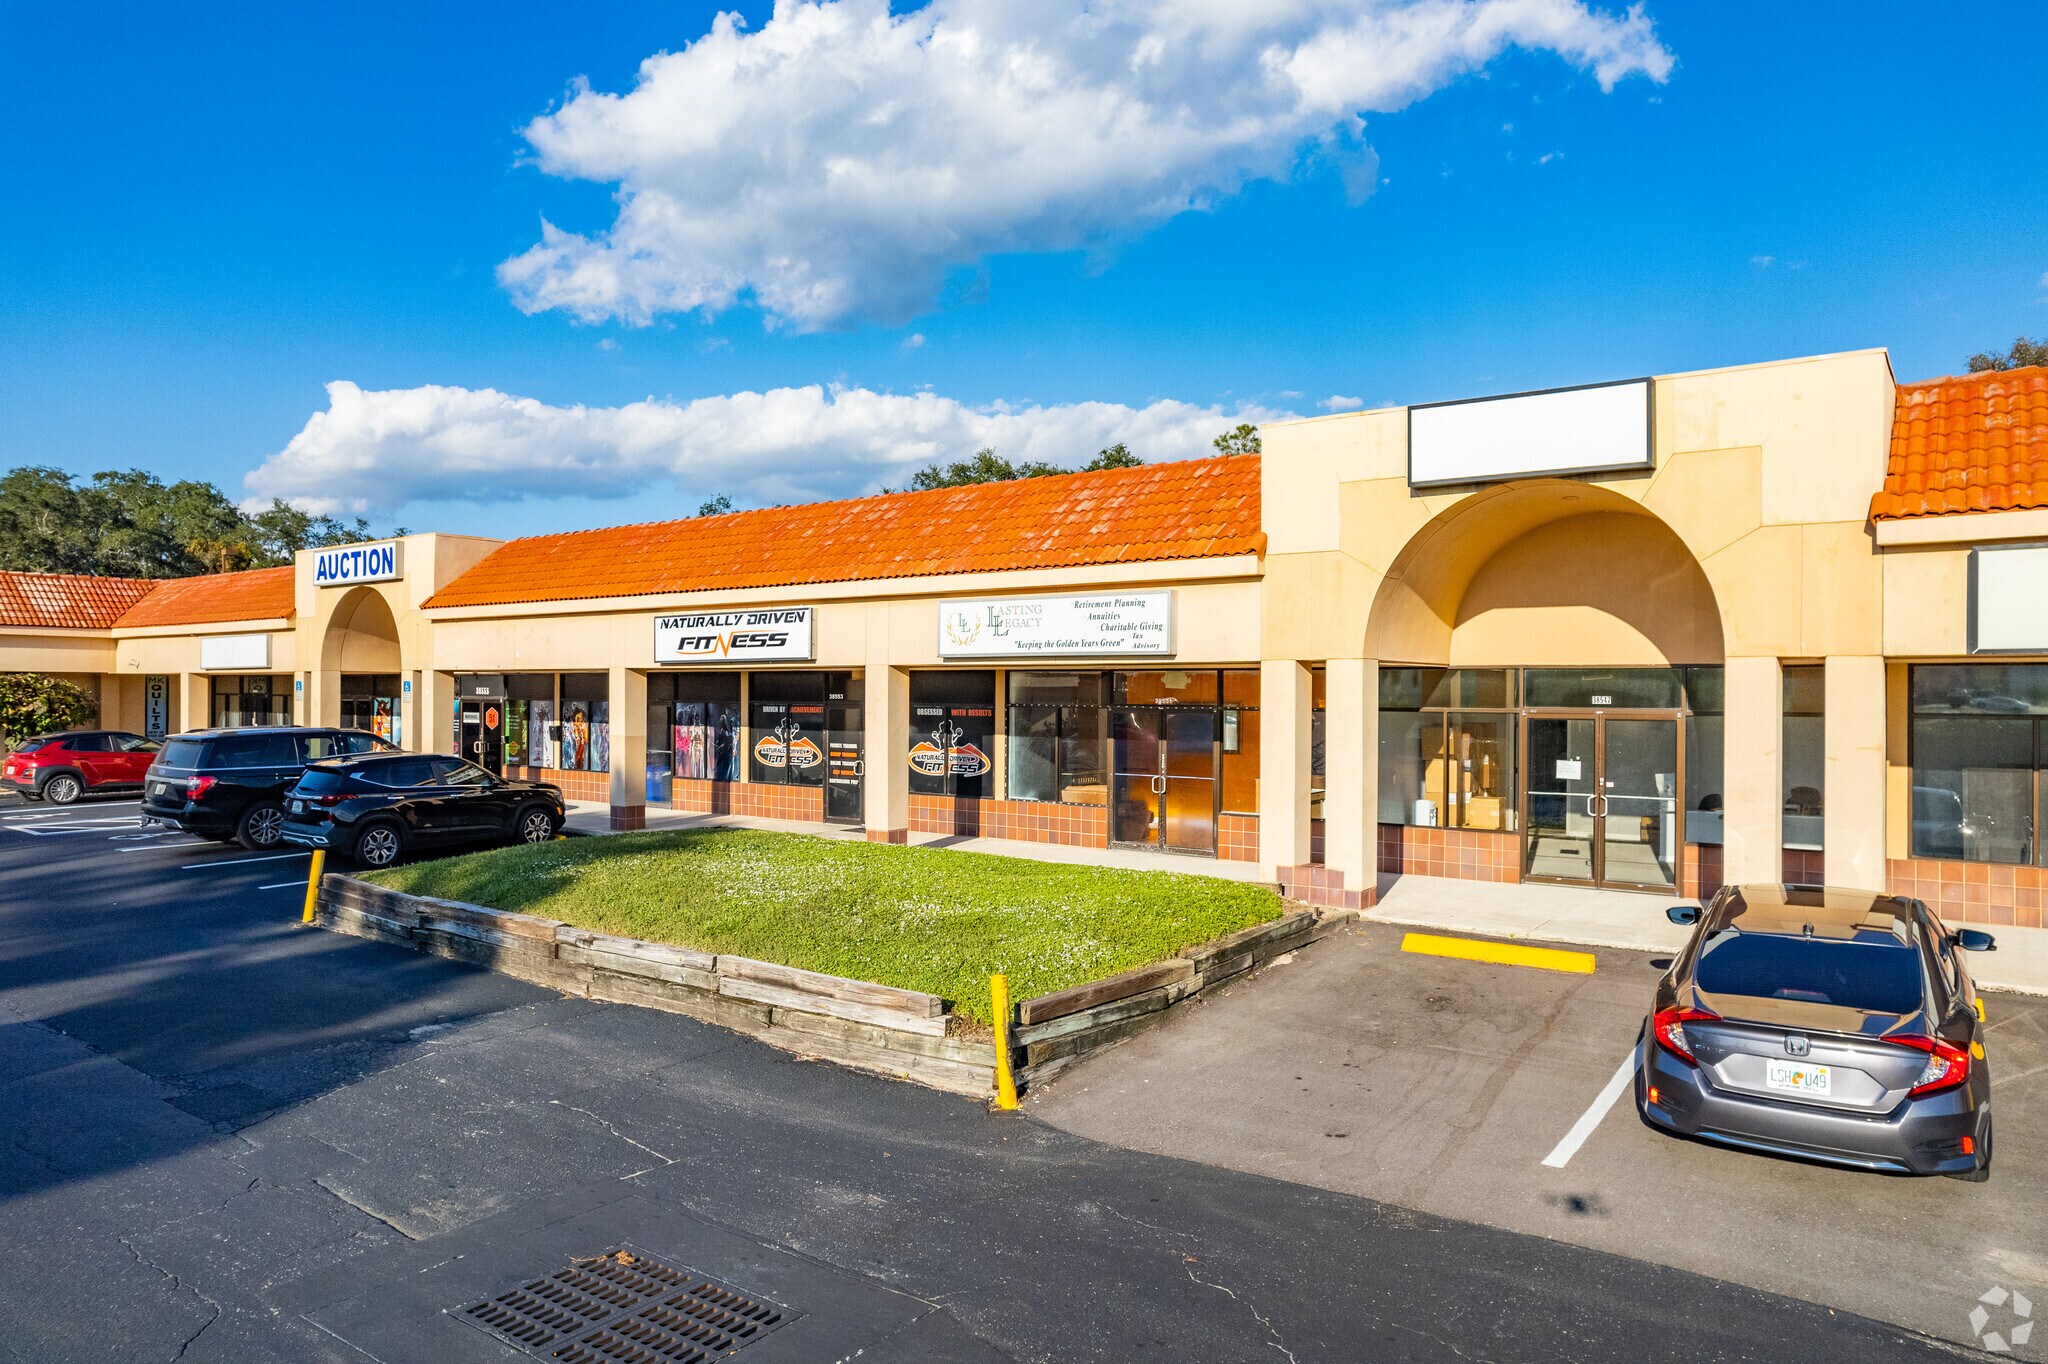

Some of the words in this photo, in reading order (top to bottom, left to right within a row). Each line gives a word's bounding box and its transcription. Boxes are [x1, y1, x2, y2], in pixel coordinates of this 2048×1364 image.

[316, 546, 393, 581] AUCTION
[1074, 600, 1111, 609] Retirement
[1114, 598, 1146, 608] Planning
[660, 615, 743, 630] NATURALLY
[746, 611, 806, 626] DRIVEN
[1087, 612, 1121, 621] Annuities
[1100, 622, 1138, 632] Charitable
[1139, 621, 1163, 632] Giving
[1132, 632, 1144, 640] Tax
[677, 631, 789, 658] FITNESS
[1014, 640, 1042, 651] "Keeping
[1043, 640, 1055, 649] the
[1056, 639, 1080, 649] Golden
[1081, 638, 1099, 648] Years
[1100, 638, 1125, 648] Green"
[1132, 642, 1160, 650] Advisory
[148, 676, 165, 684] MK
[1592, 696, 1611, 704] 38547
[151, 684, 161, 730] QUILTS
[762, 705, 779, 713] DRIVEN
[779, 705, 786, 713] BY
[917, 708, 943, 716] OBSESSED
[488, 713, 496, 724] 51
[951, 709, 967, 717] WITH
[968, 709, 992, 717] RESULTS
[768, 755, 812, 764] FITESS
[923, 762, 979, 773] FITESS
[1770, 1068, 1792, 1083] LSH
[1805, 1072, 1827, 1089] U49
